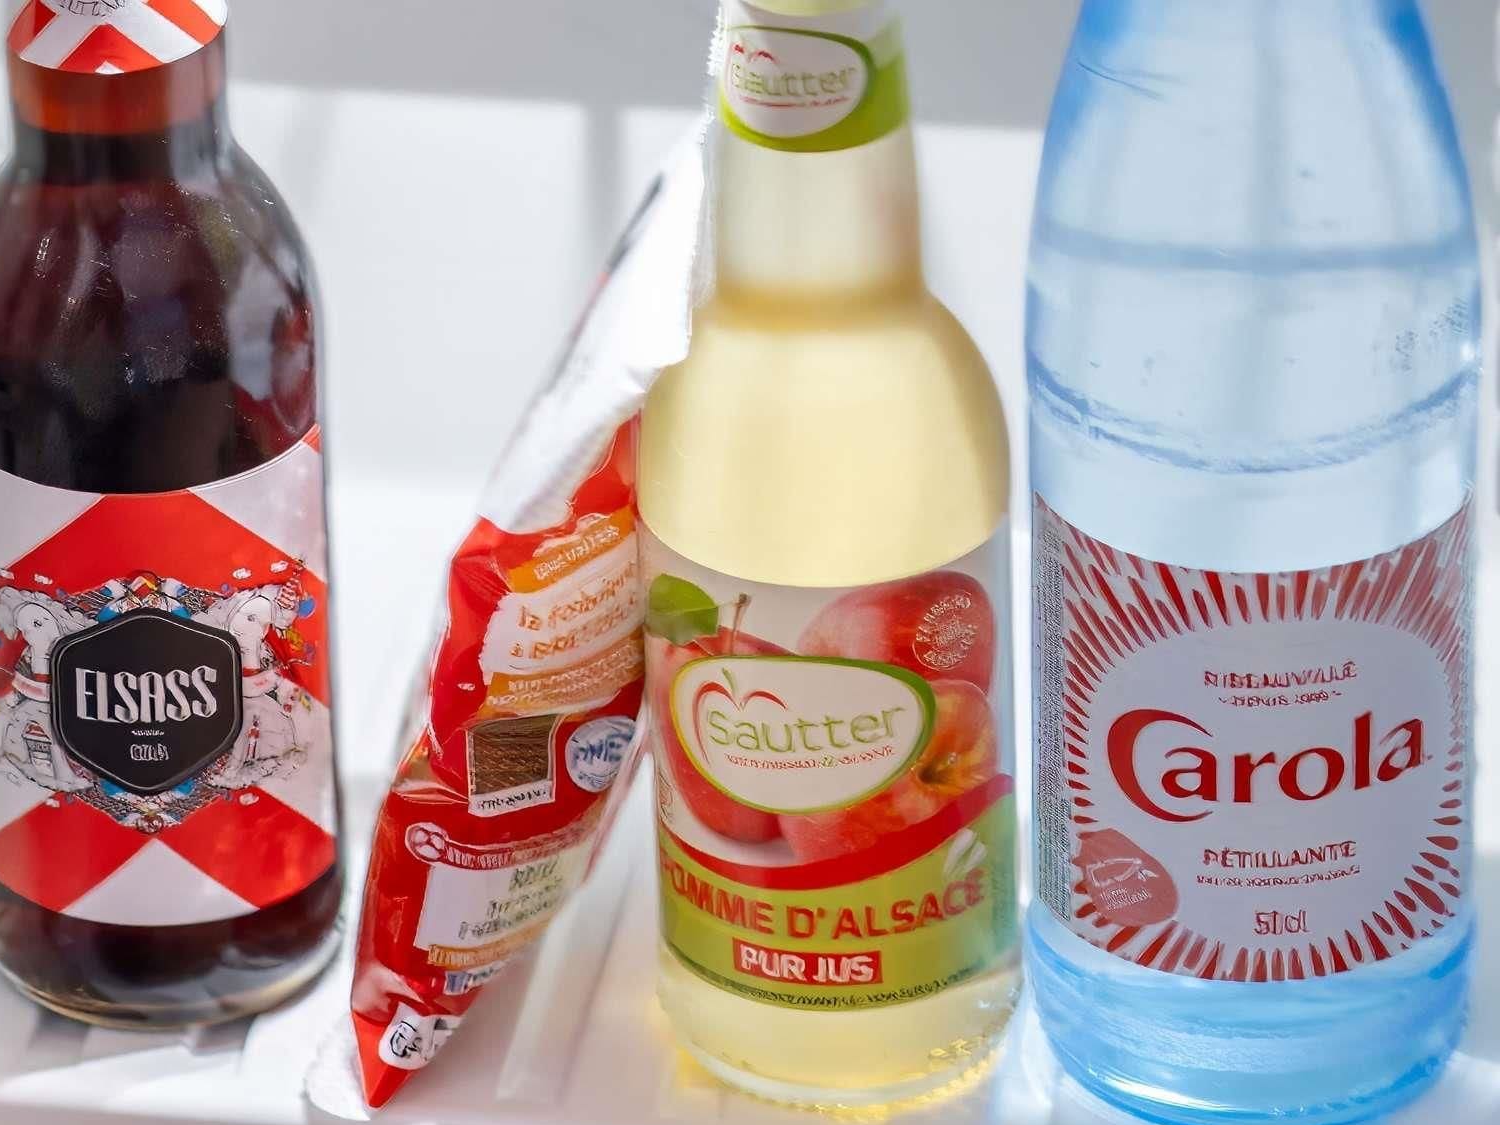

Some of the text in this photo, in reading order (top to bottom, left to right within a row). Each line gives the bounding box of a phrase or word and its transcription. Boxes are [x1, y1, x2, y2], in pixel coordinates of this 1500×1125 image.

[75, 664, 218, 724] ELSASS
[707, 706, 905, 754] sautter
[1106, 708, 1424, 823] Carola
[1203, 840, 1357, 869] PÉTILLANTE
[786, 867, 986, 940] D'ALSACE
[740, 944, 807, 981] PUR
[813, 955, 874, 983] JUS
